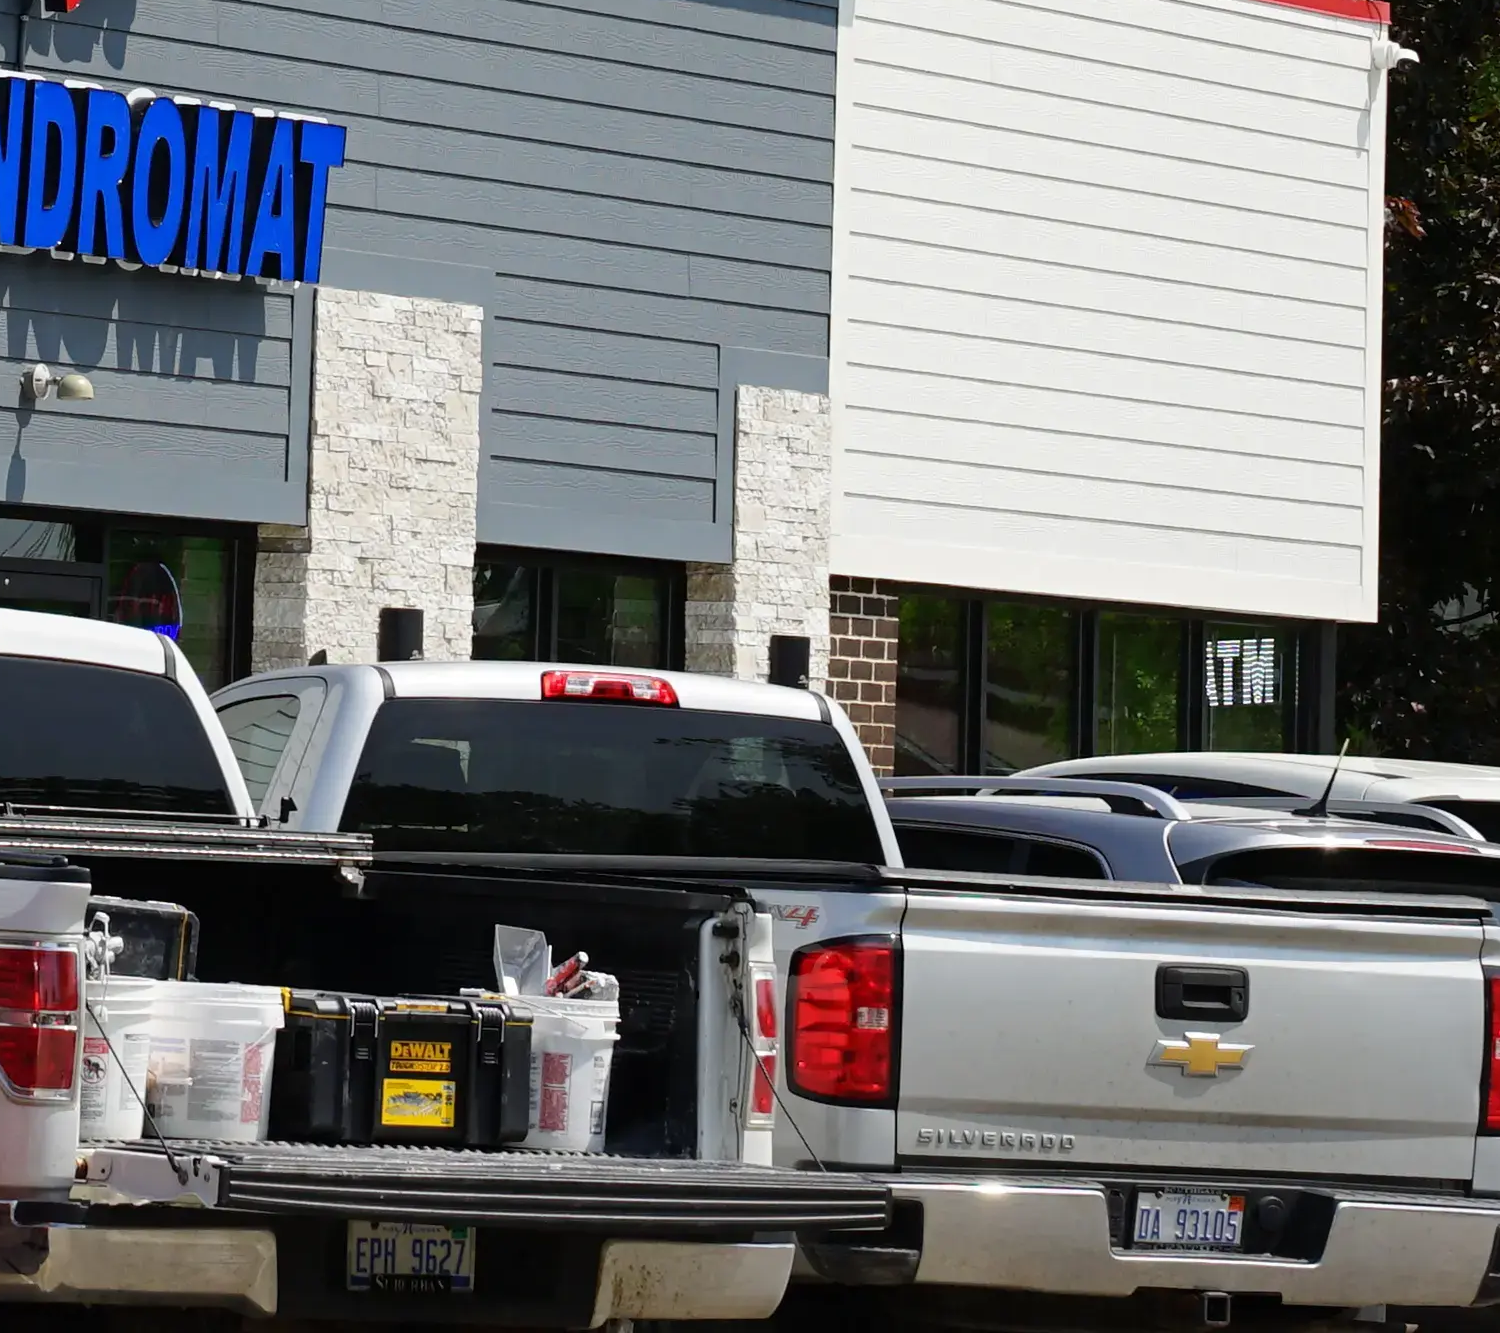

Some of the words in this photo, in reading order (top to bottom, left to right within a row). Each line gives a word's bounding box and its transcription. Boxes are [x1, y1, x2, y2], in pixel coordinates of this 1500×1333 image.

[391, 1041, 451, 1060] DEWALT
[916, 1128, 1076, 1150] SILVERADO
[1175, 1209, 1239, 1242] 93105
[356, 1237, 396, 1274] EPH
[411, 1238, 466, 1275] 9627
